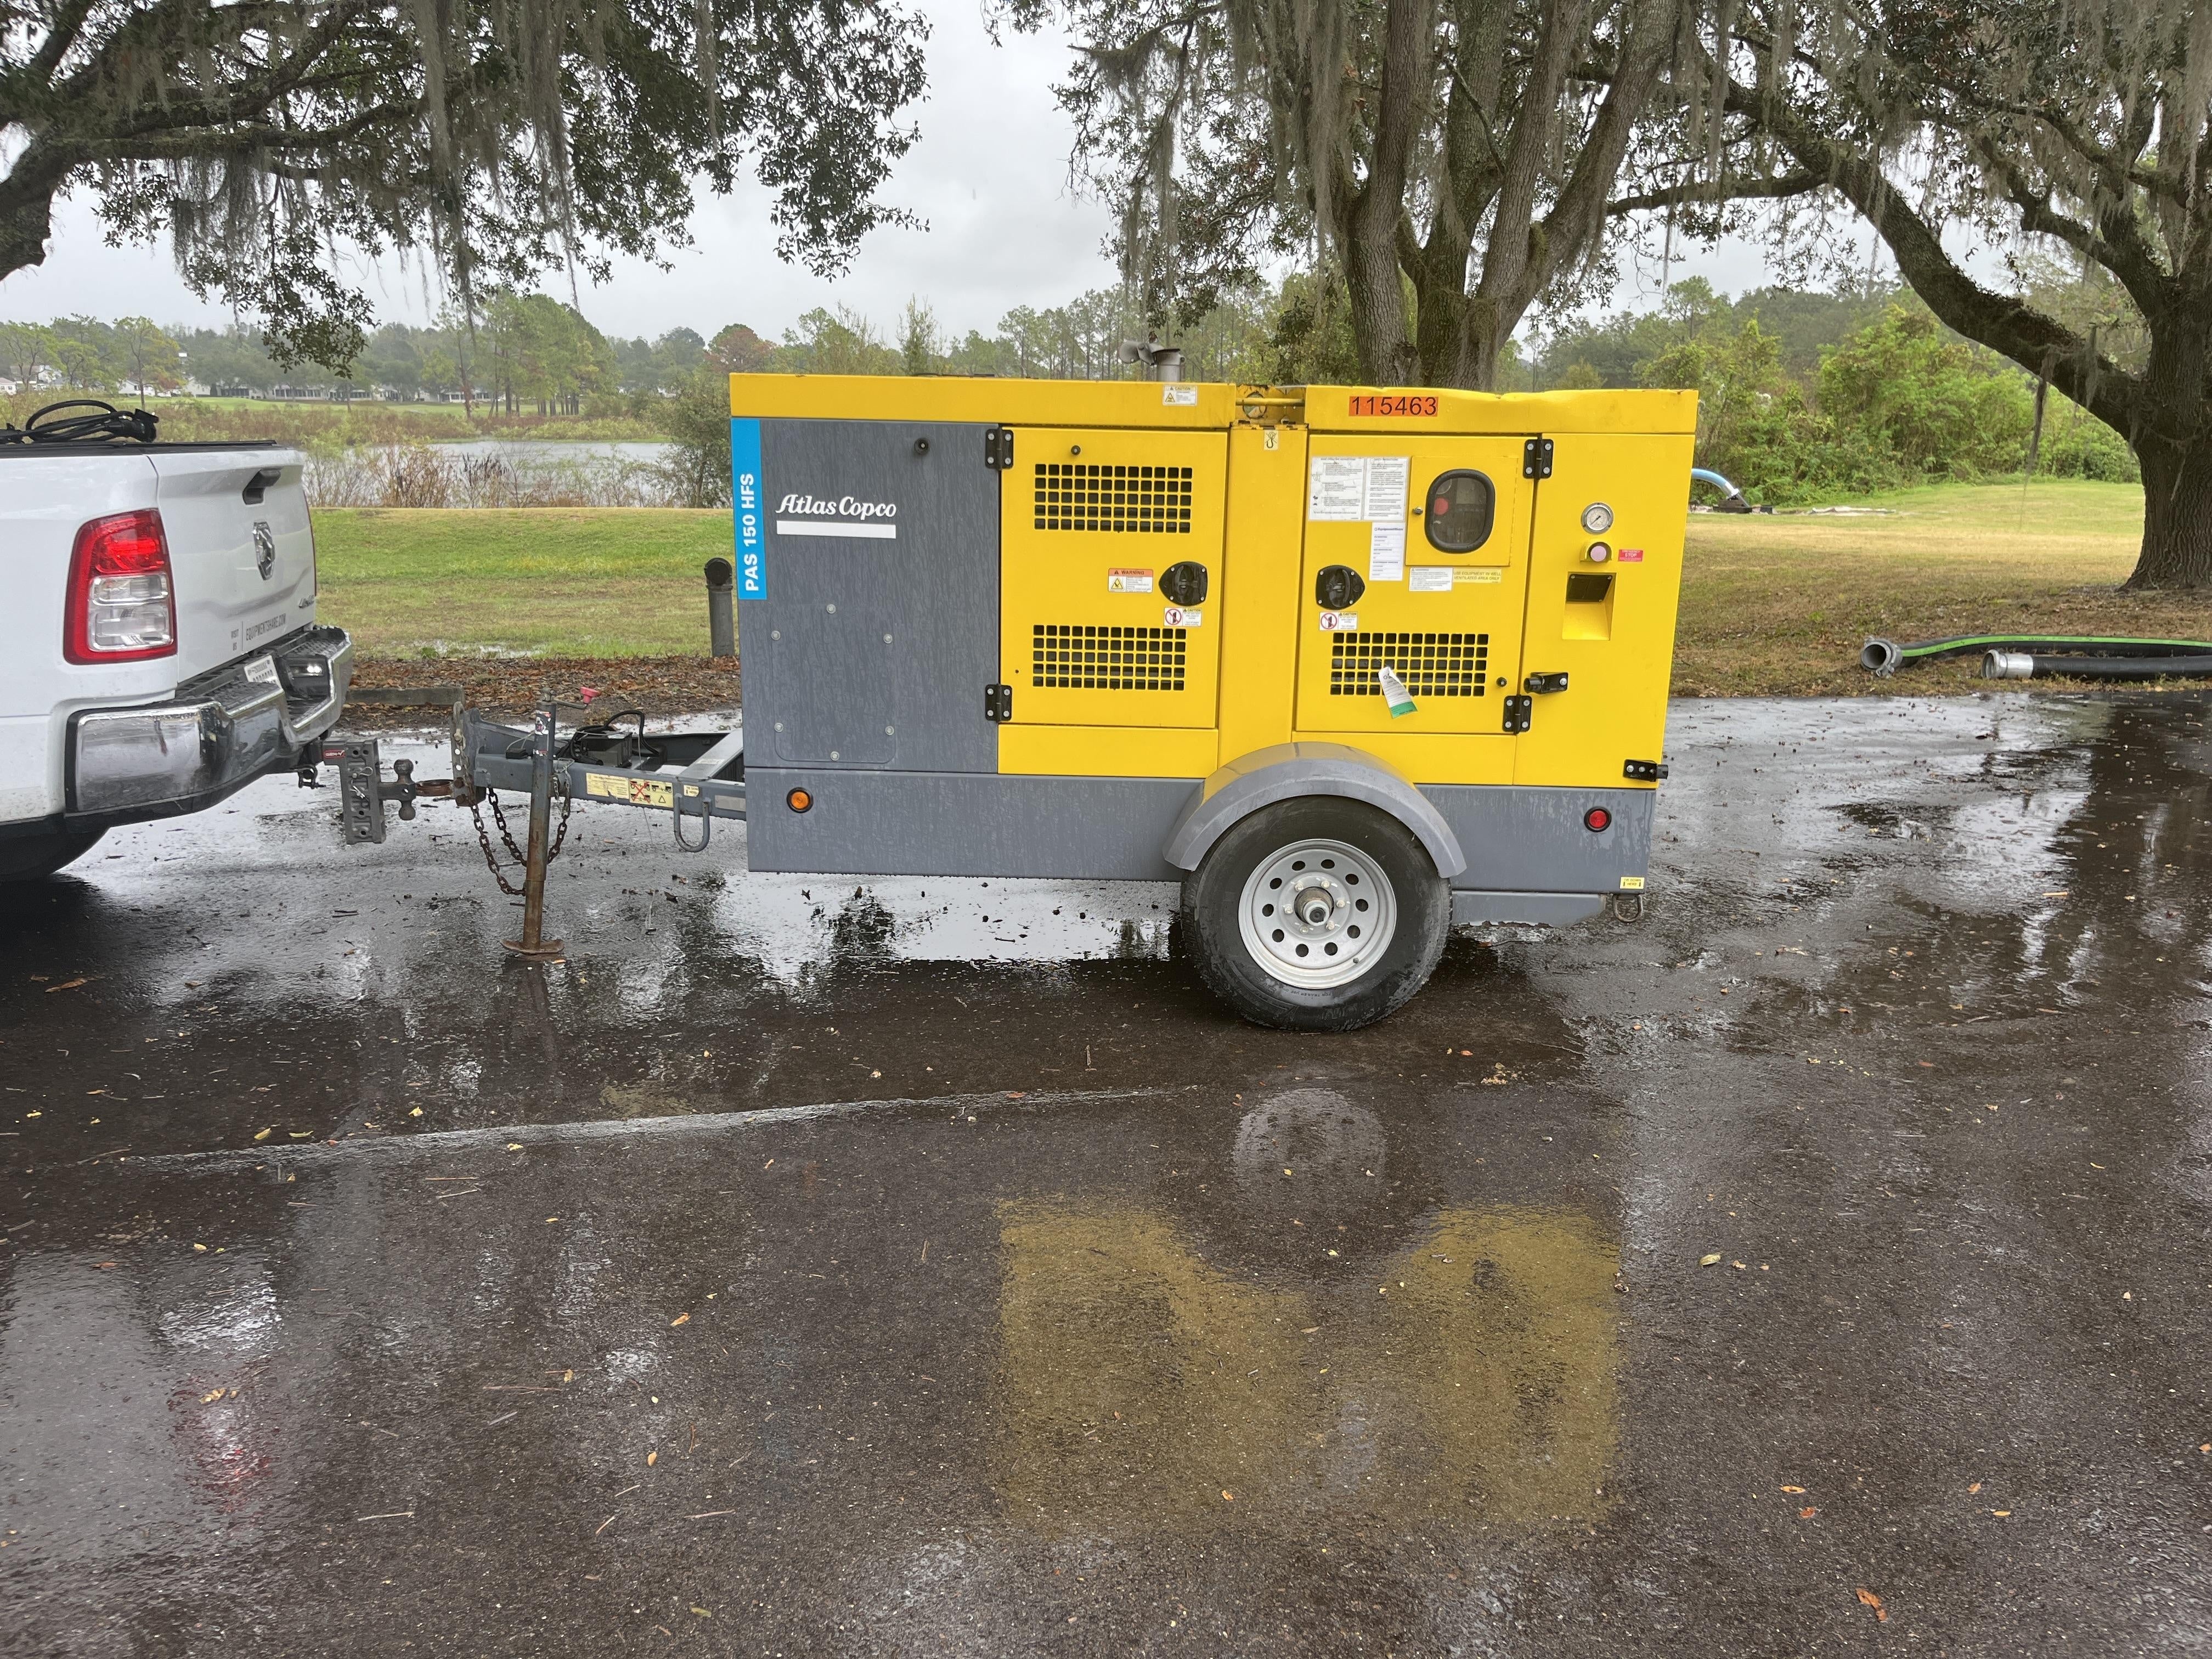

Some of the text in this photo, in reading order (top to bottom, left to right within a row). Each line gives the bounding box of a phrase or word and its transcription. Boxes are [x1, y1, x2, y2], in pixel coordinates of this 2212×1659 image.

[1352, 396, 1437, 416] 115463
[775, 494, 896, 521] Atlas Copco
[740, 473, 759, 591] PAS 150 HFS
